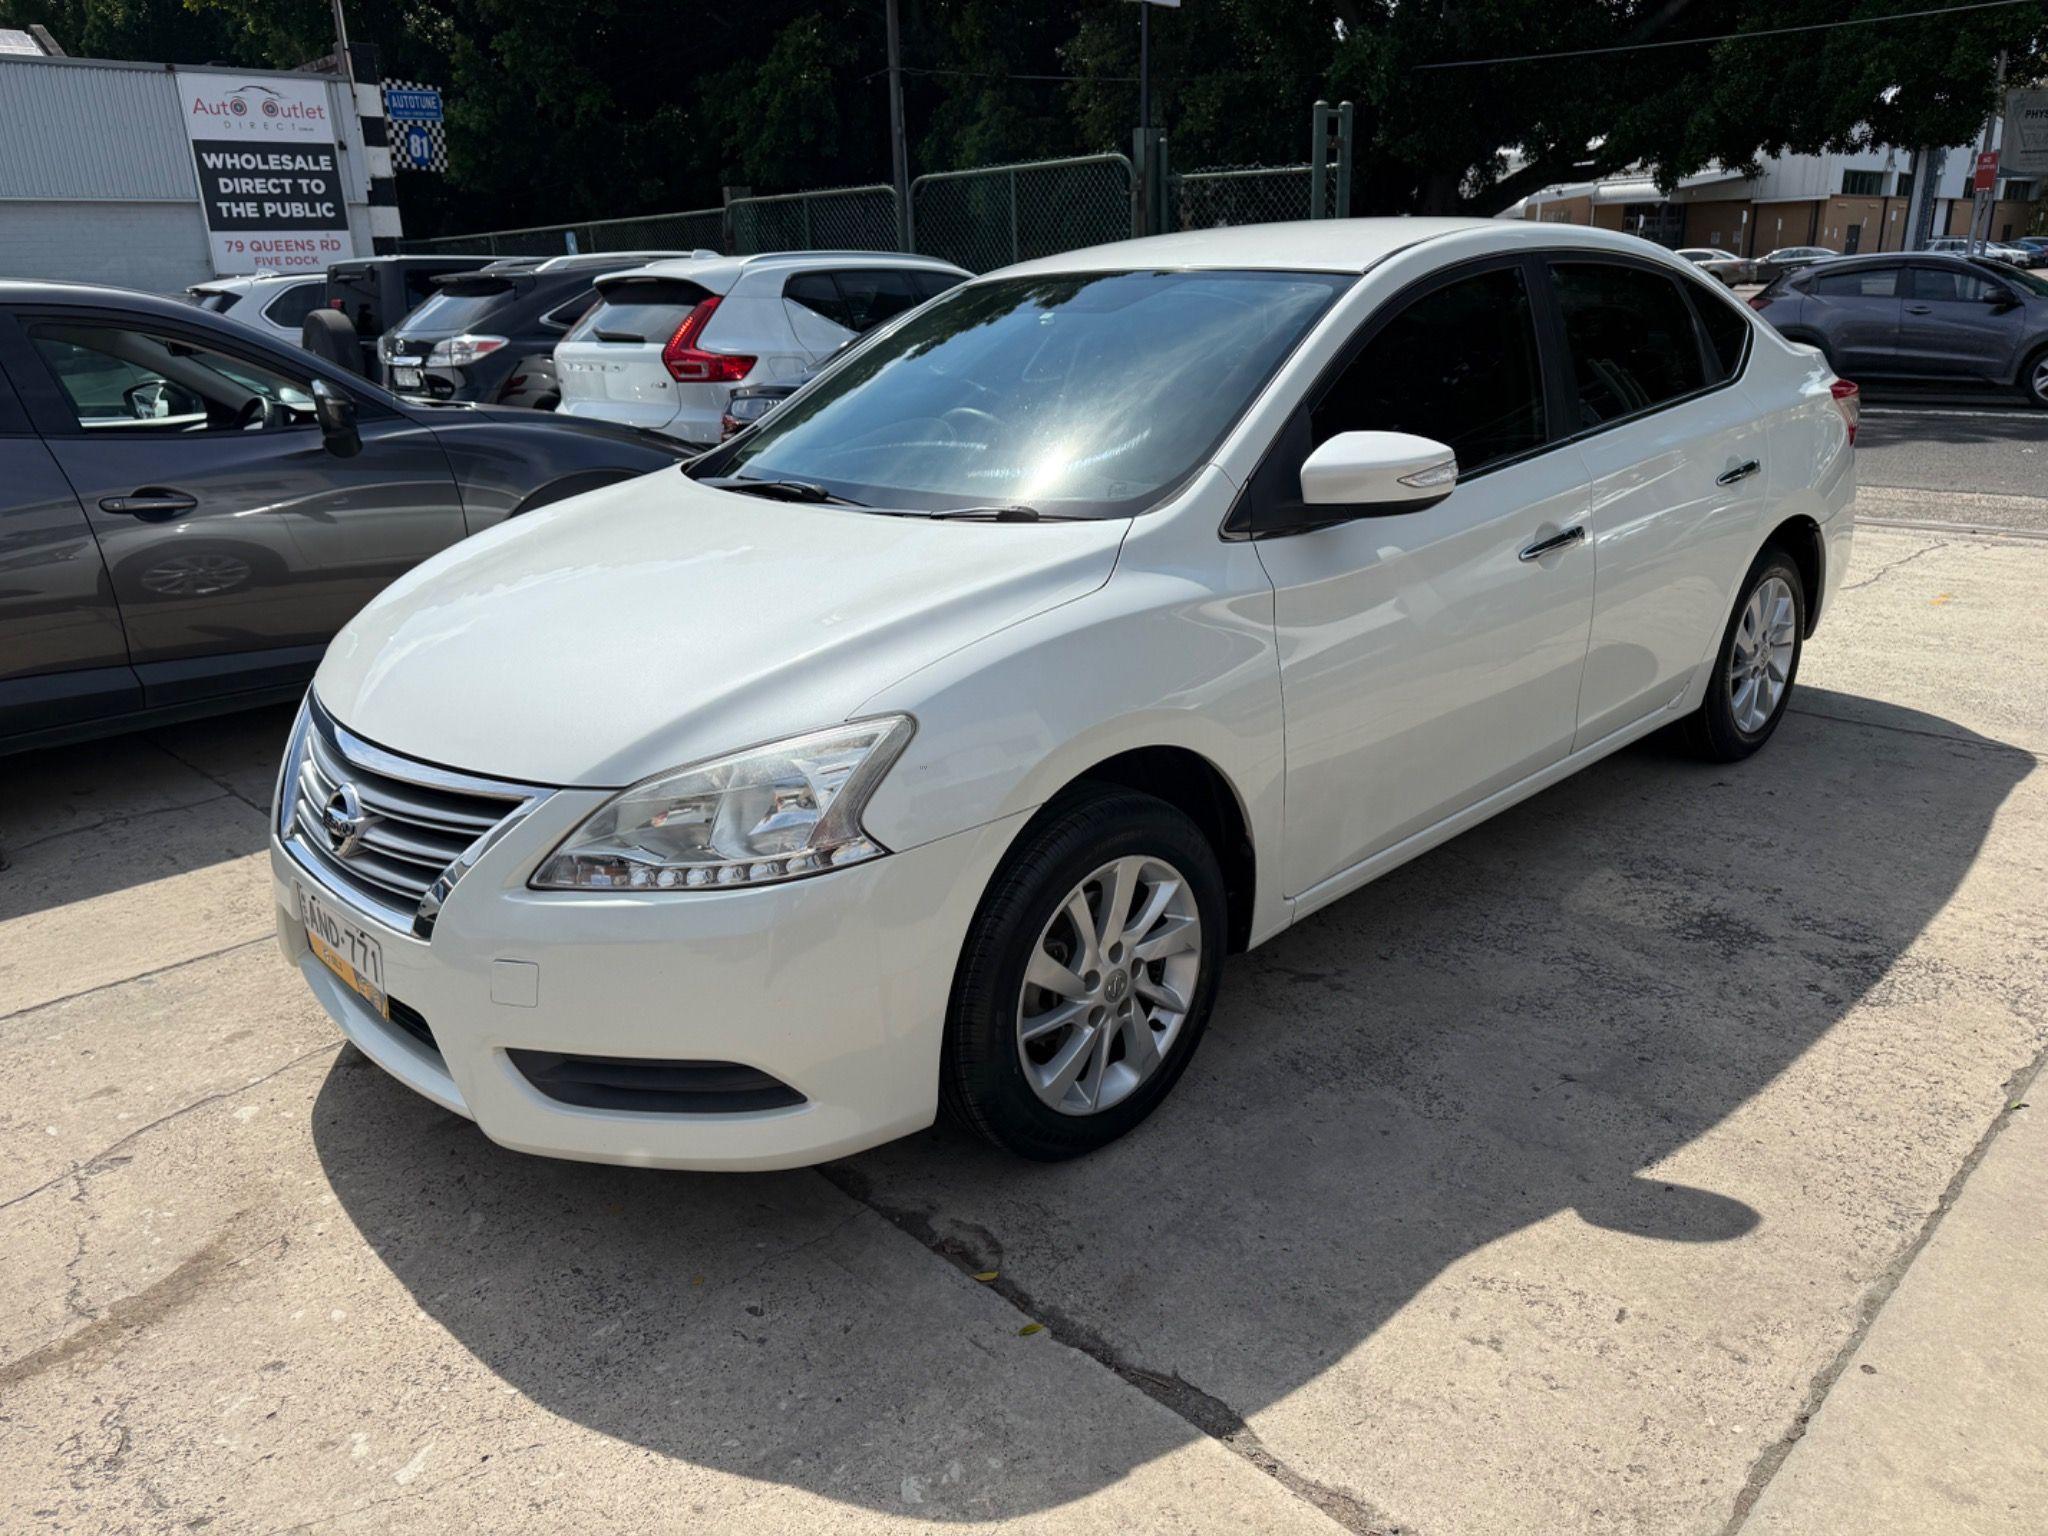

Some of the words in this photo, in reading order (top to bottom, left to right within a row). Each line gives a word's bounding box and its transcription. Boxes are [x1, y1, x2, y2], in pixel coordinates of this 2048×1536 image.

[262, 100, 326, 120] Outlet
[392, 95, 438, 110] AUTOTUNE
[224, 121, 296, 132] DIRECT
[410, 134, 430, 159] 81
[202, 152, 333, 171] WHOLESALE
[218, 177, 293, 194] DIRECT
[297, 178, 326, 195] TO
[216, 201, 260, 218] THE
[264, 202, 336, 218] PUBLIC
[225, 240, 245, 253] 79
[250, 239, 316, 253] QUEENS
[320, 239, 341, 252] RD
[254, 256, 281, 266] FIVE
[285, 255, 320, 266] DOCK
